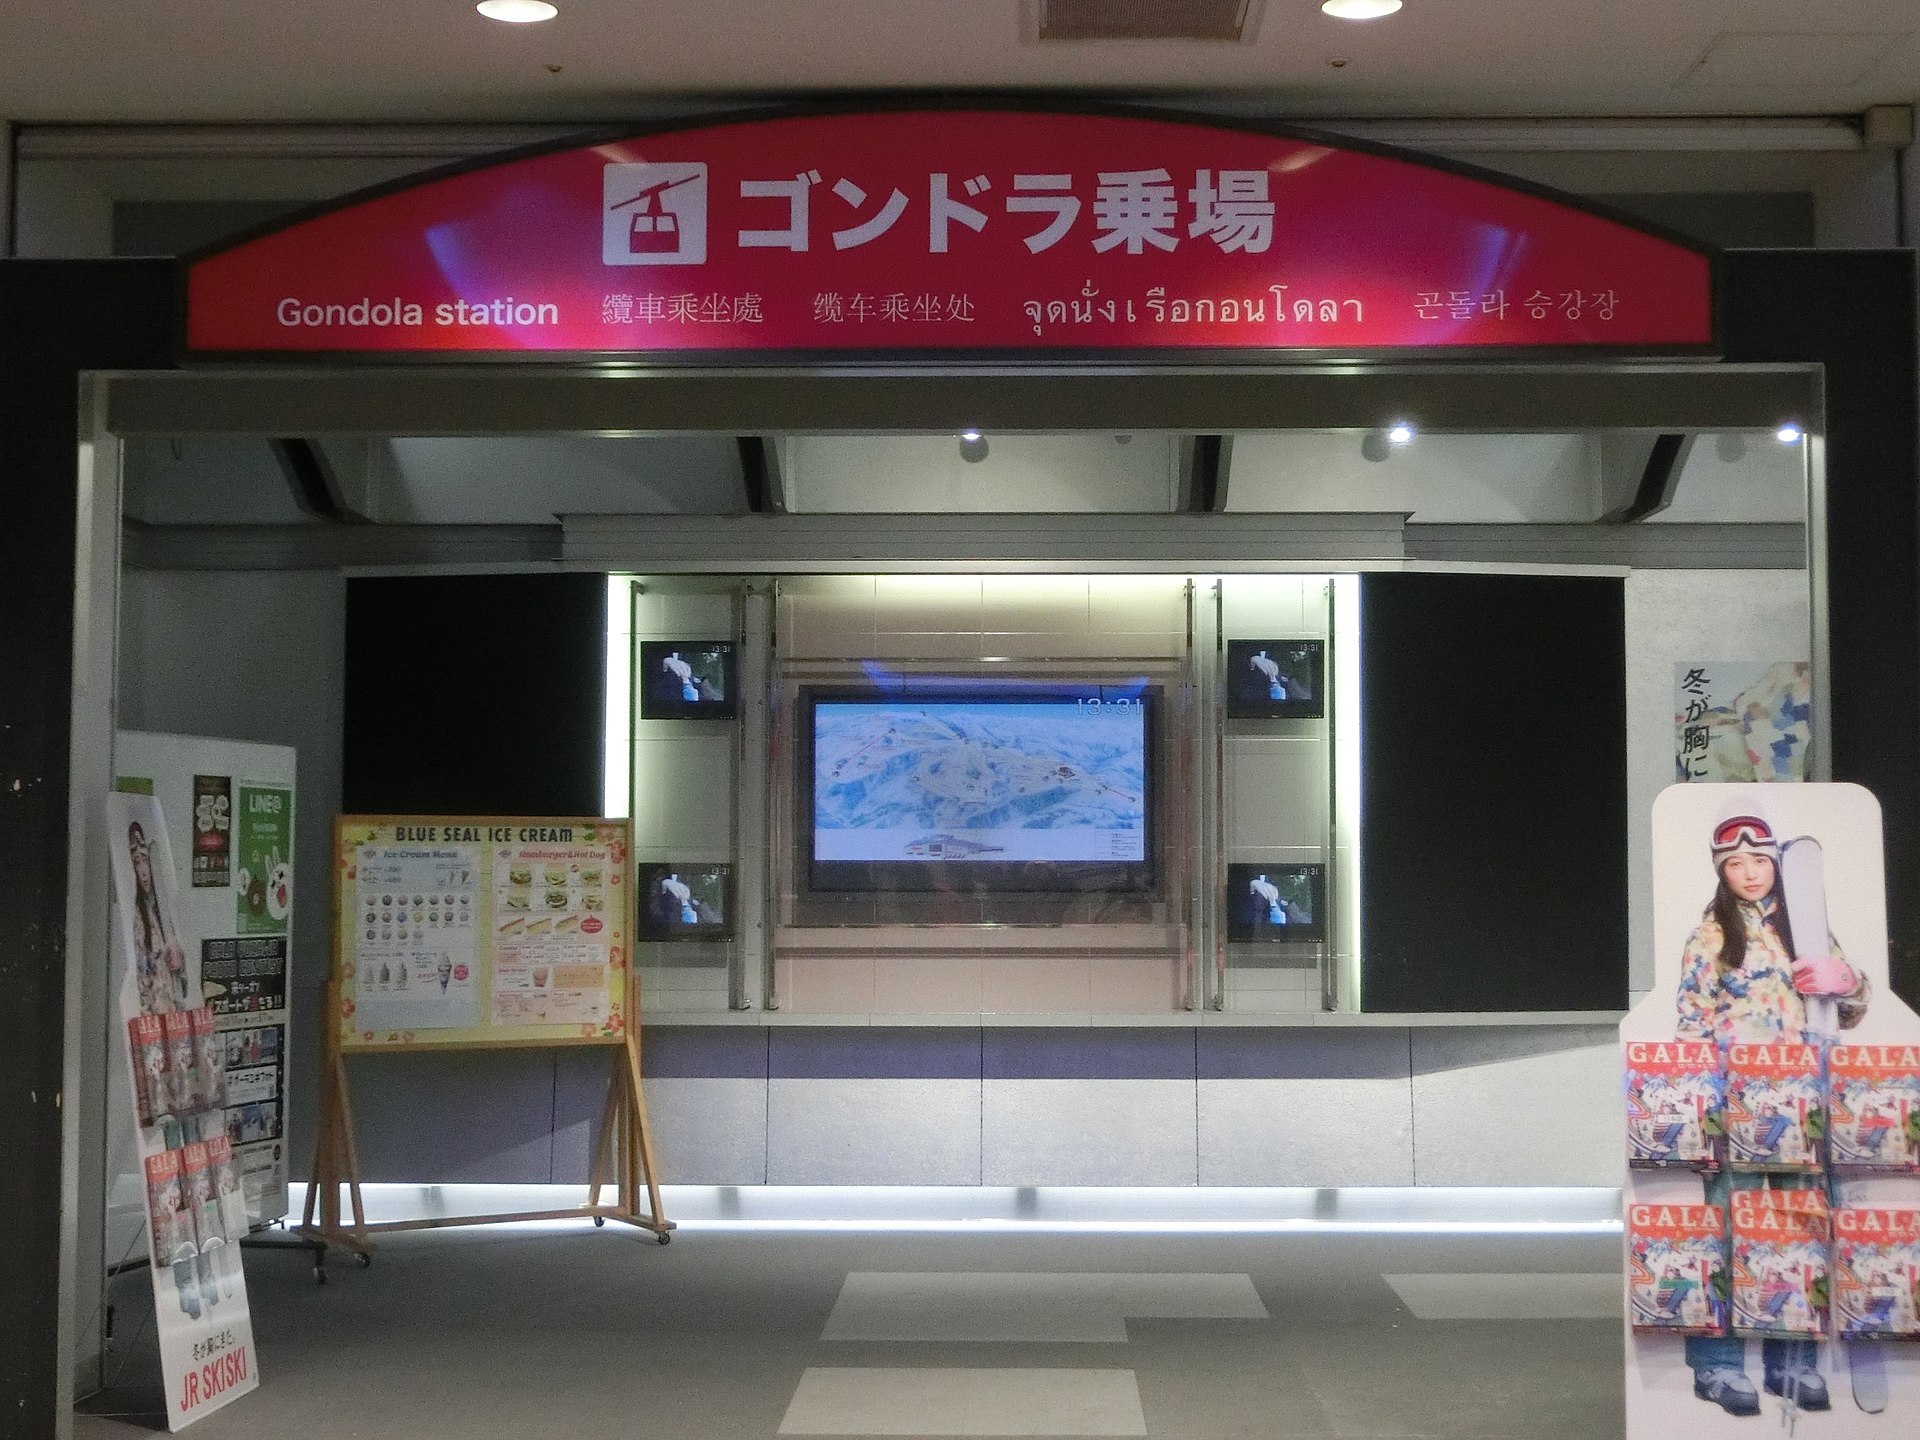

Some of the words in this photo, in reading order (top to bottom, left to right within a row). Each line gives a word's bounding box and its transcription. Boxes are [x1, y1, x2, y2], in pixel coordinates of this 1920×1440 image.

[738, 168, 1276, 255] ゴンドラ乗場
[276, 297, 424, 327] Gondola
[435, 297, 559, 326] station
[813, 292, 976, 324] 缆车乘坐处
[1413, 289, 1511, 321] 곤돌라
[1523, 289, 1620, 321] 승강장
[1077, 698, 1141, 715] 13:31
[1681, 668, 1711, 782] 冬が胸に
[396, 827, 437, 842] BLUE
[444, 827, 481, 842] SEAL
[489, 828, 512, 842] ICE
[519, 828, 573, 842] CREAM
[1628, 1043, 1716, 1063] GALA
[1730, 1045, 1819, 1065] GALA
[1830, 1046, 1919, 1067] GALA
[1731, 1190, 1822, 1211] GALA
[1631, 1205, 1720, 1227] GALA
[1735, 1208, 1825, 1232] GALA
[180, 1371, 200, 1411] JR
[202, 1346, 248, 1399] SKISKI
